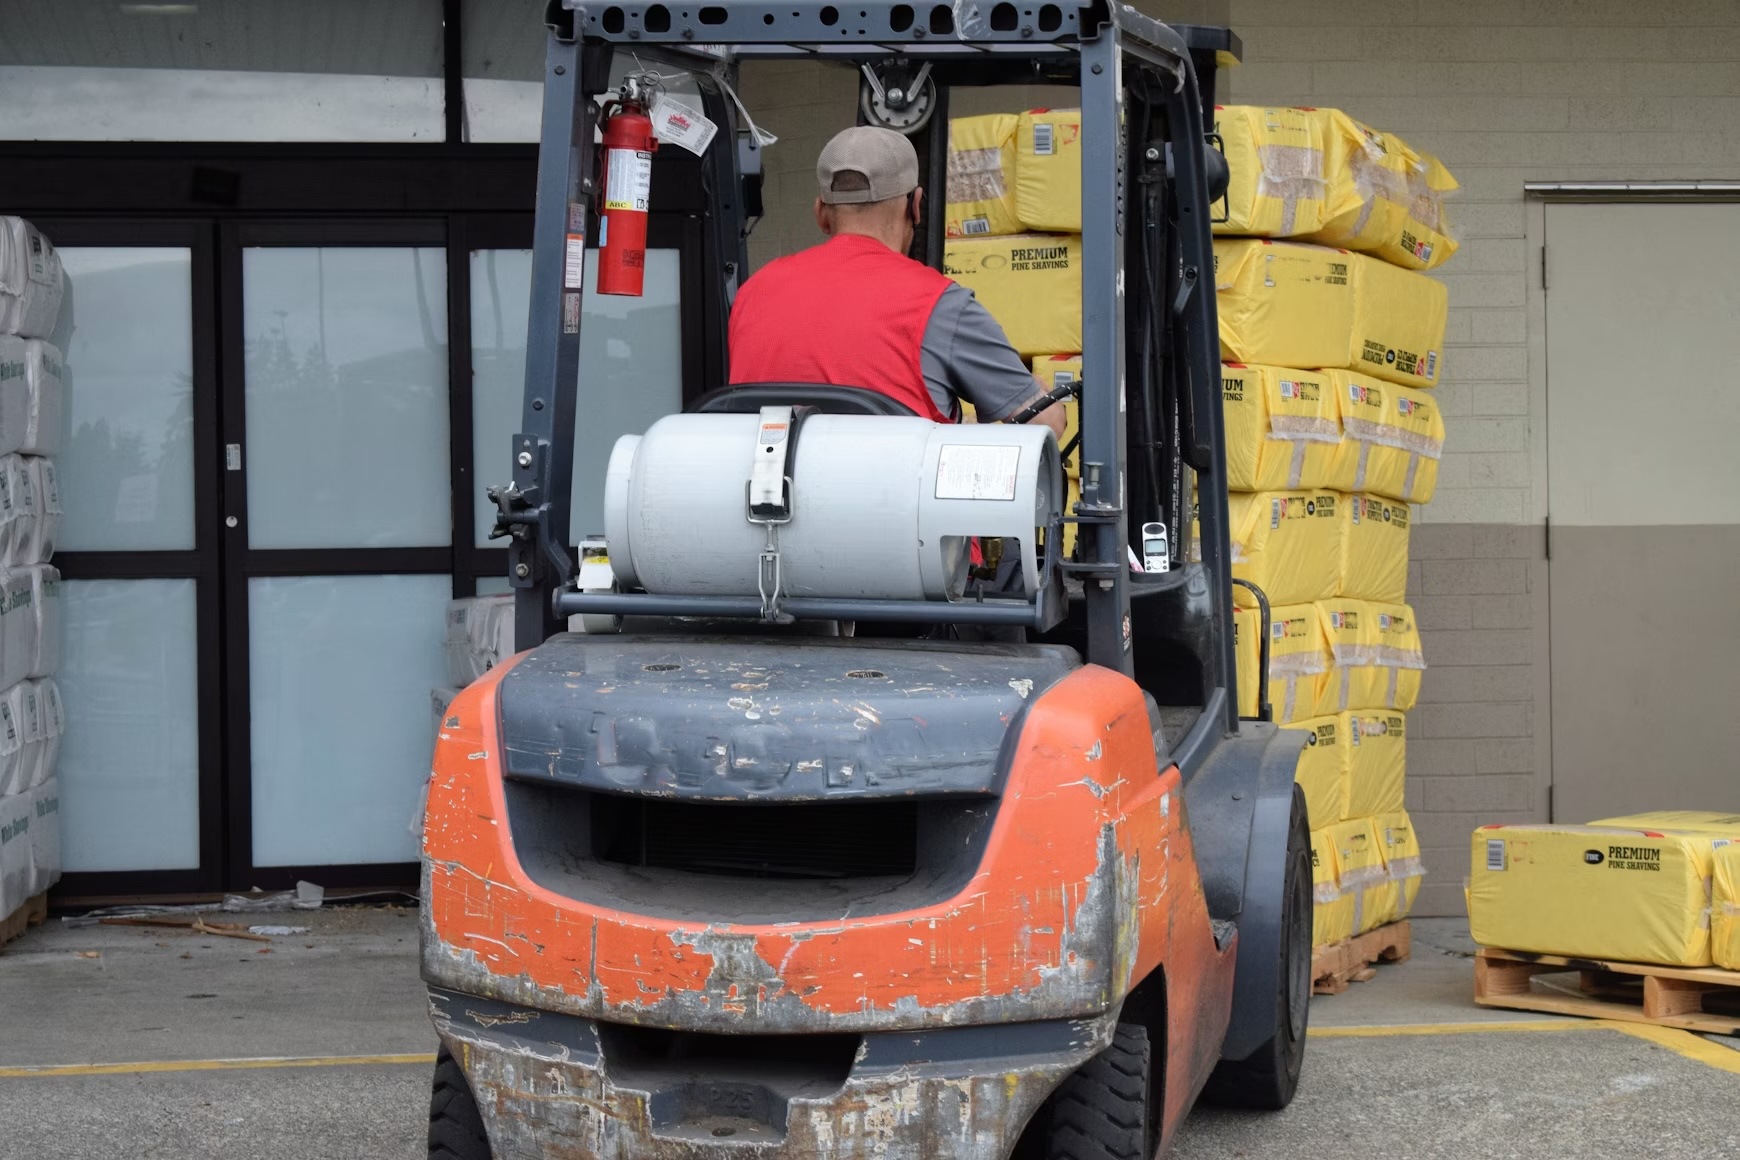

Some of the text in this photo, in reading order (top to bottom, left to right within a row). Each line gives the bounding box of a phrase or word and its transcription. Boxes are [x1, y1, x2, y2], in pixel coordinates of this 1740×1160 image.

[1011, 247, 1068, 261] PREMIUM
[1011, 260, 1069, 271] PINE SHAVINGS
[1608, 846, 1660, 861] PREMIUM
[1608, 861, 1660, 871] PINE SHAVINGS
